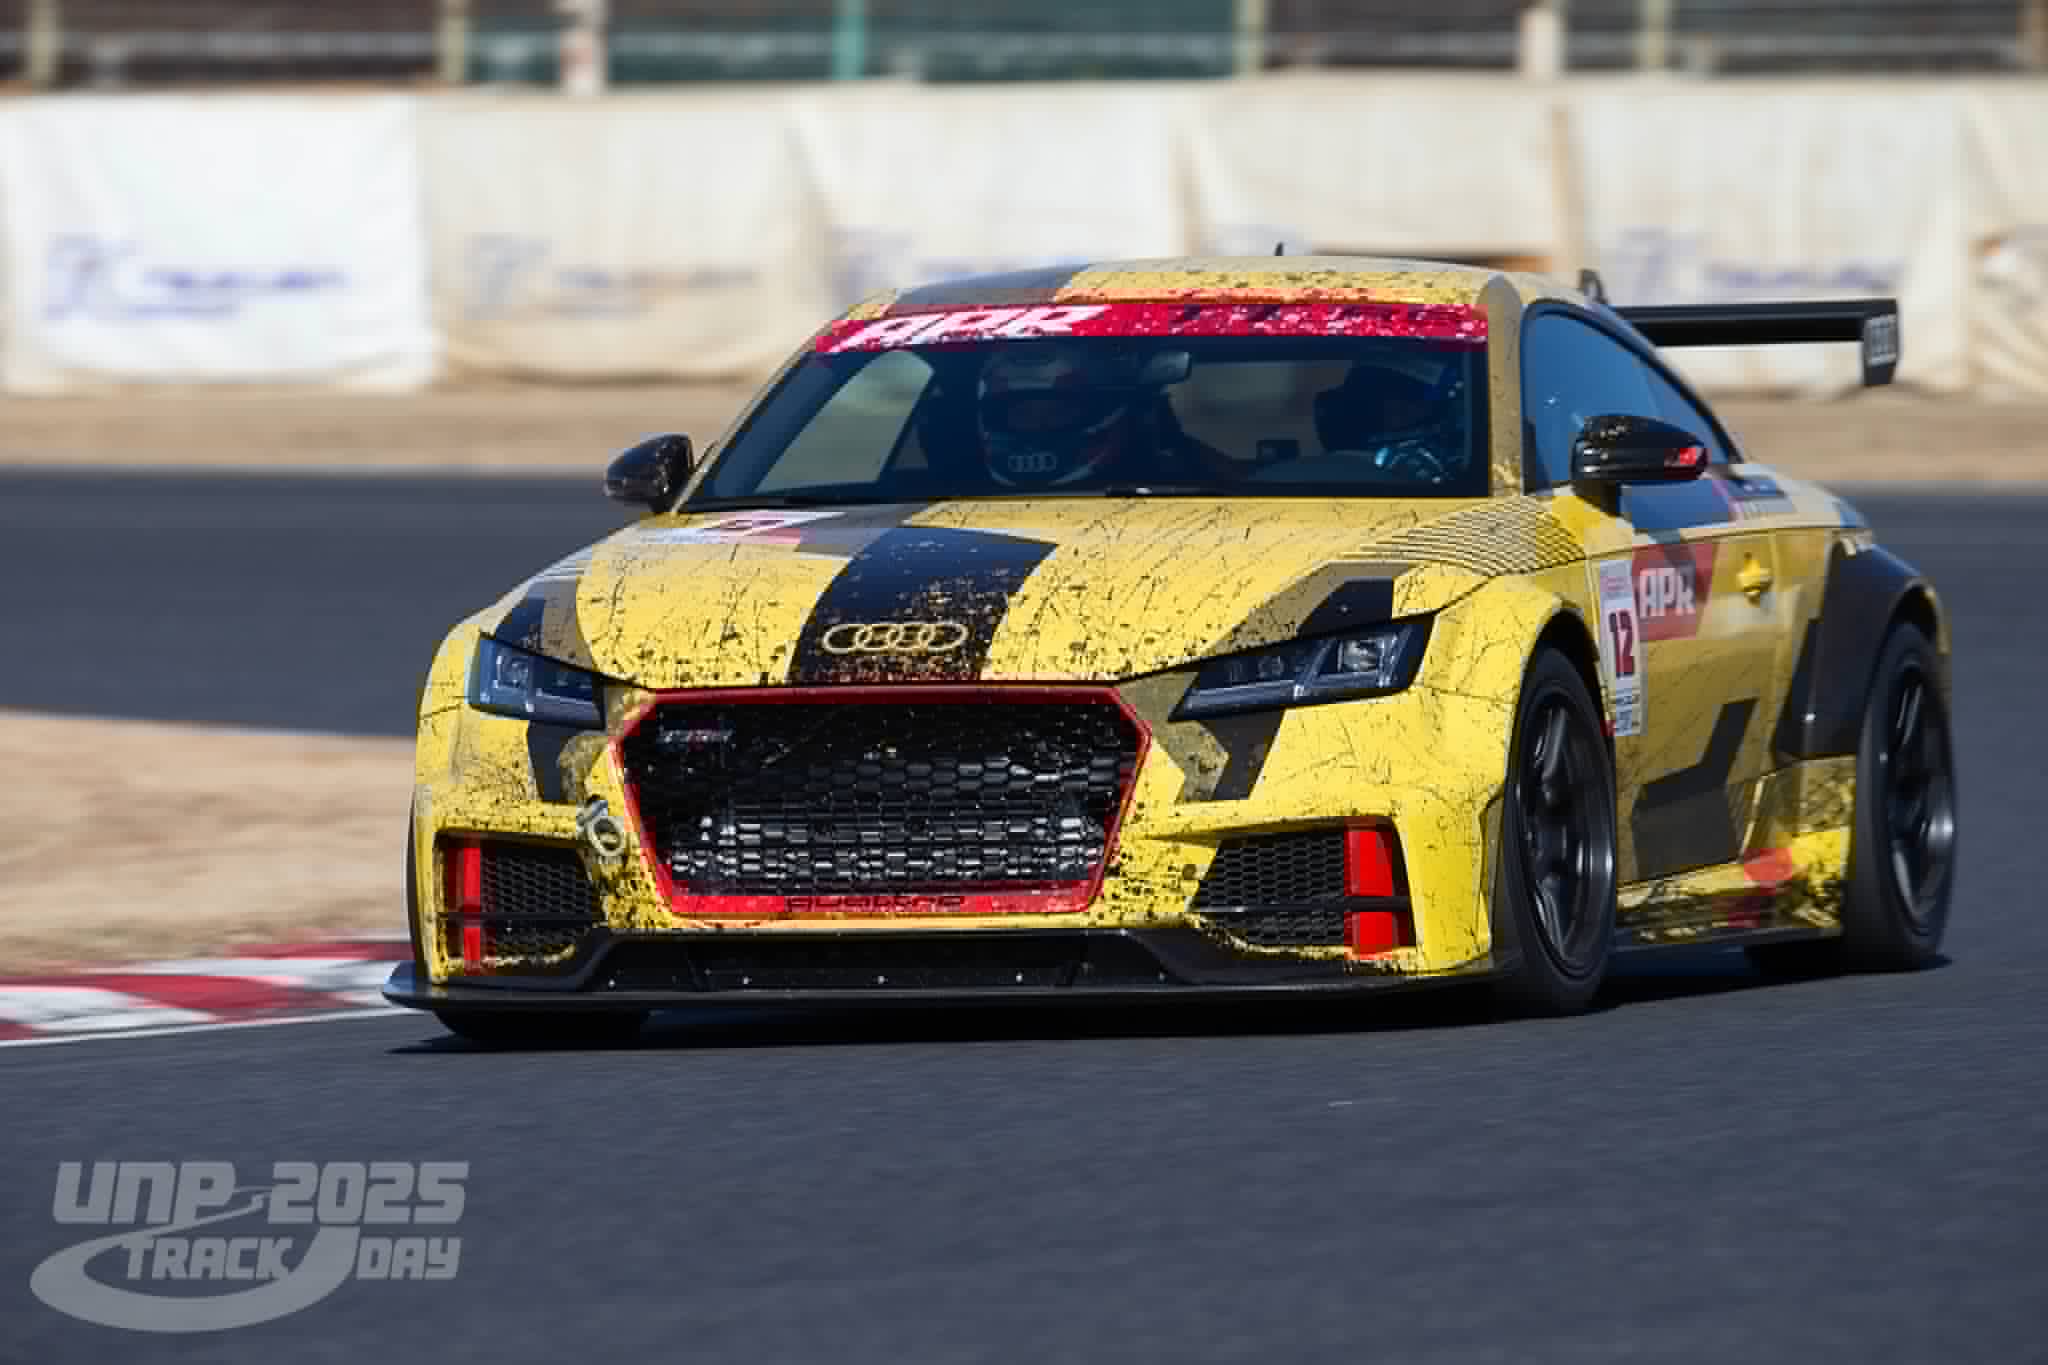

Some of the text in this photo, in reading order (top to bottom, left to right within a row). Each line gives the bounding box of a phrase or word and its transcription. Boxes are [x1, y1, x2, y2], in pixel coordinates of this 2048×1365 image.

[829, 304, 1112, 353] APR
[1638, 566, 1696, 620] APR
[1609, 610, 1635, 678] 12
